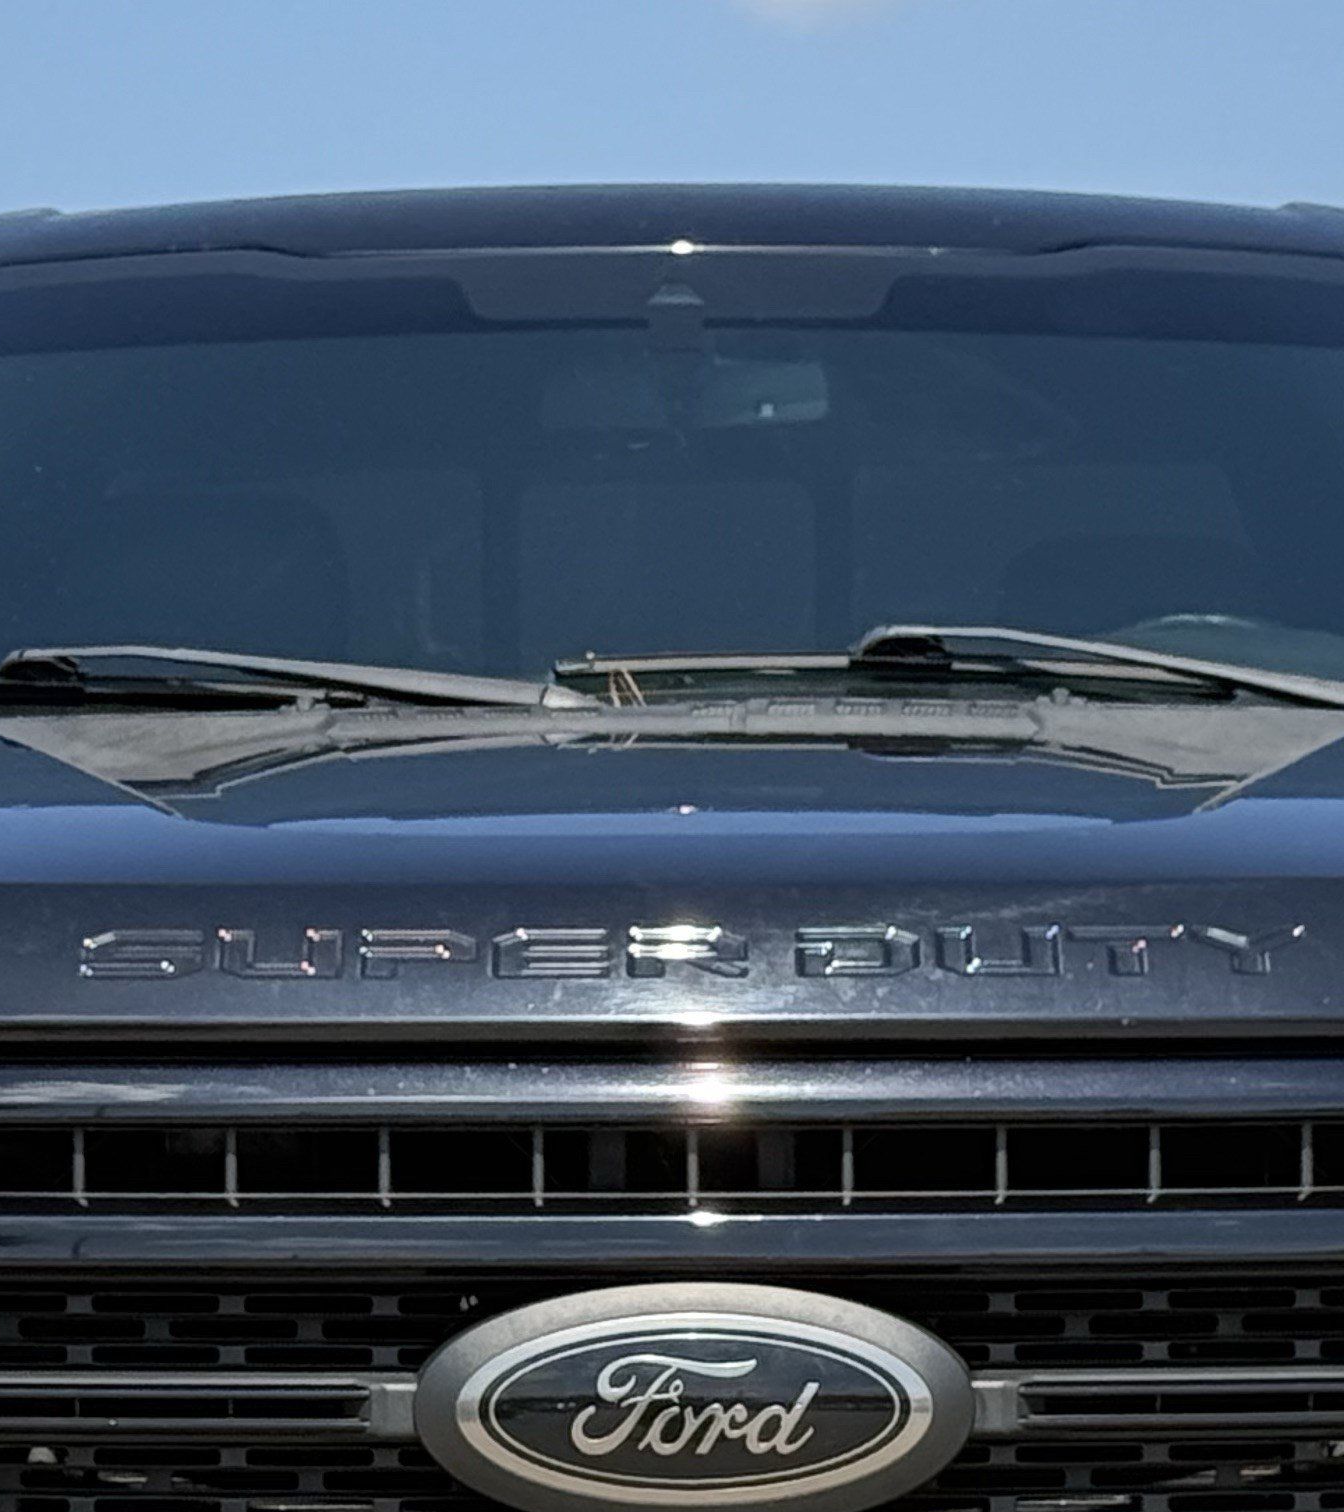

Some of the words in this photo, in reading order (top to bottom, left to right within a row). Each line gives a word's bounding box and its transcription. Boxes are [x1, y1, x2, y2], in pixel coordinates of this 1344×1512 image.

[77, 926, 750, 979] SUPER
[795, 922, 1306, 976] DUTY
[570, 1353, 821, 1456] Ford
